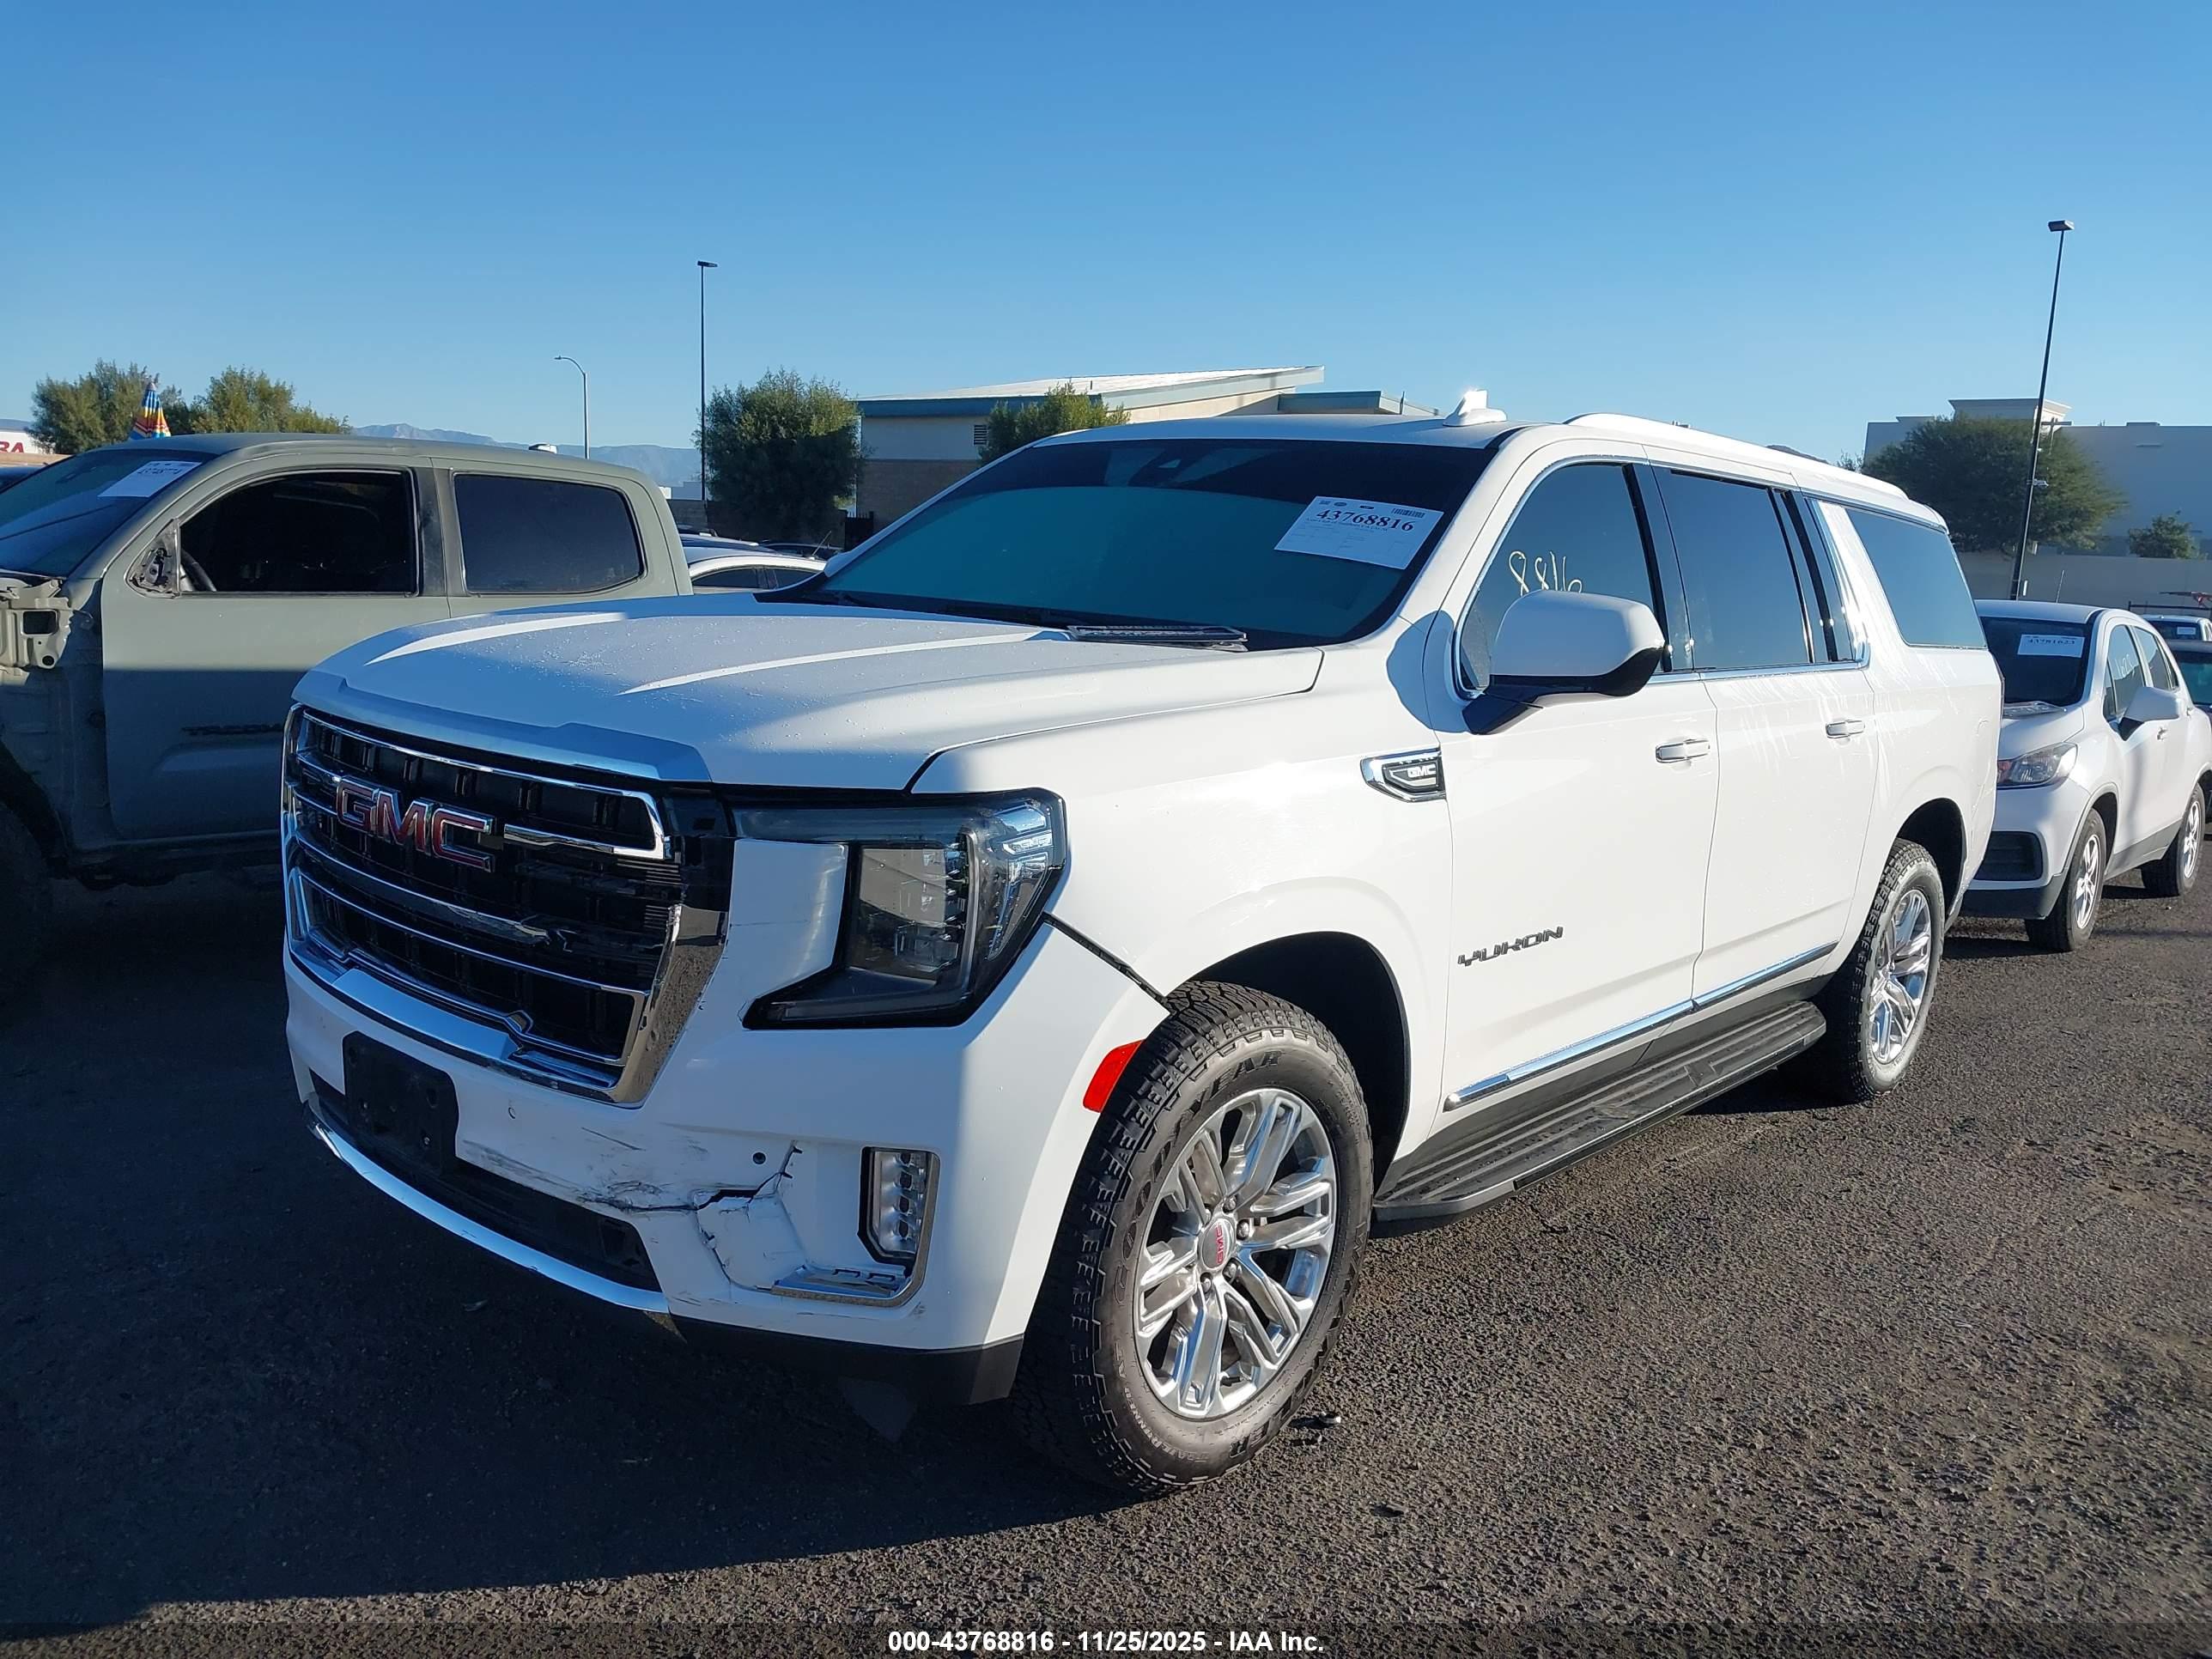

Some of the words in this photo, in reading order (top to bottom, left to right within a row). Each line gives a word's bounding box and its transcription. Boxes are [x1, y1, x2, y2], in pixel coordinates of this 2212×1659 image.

[1316, 509, 1415, 532] 43768816
[1509, 550, 1583, 597] 8816
[1407, 763, 1437, 778] GMC
[336, 775, 496, 872] GMC
[1457, 926, 1564, 967] YUKON
[1115, 1050, 1282, 1307] GOODYEAR
[1216, 1224, 1224, 1265] GMC
[1228, 1221, 1367, 1459] WRANGLER
